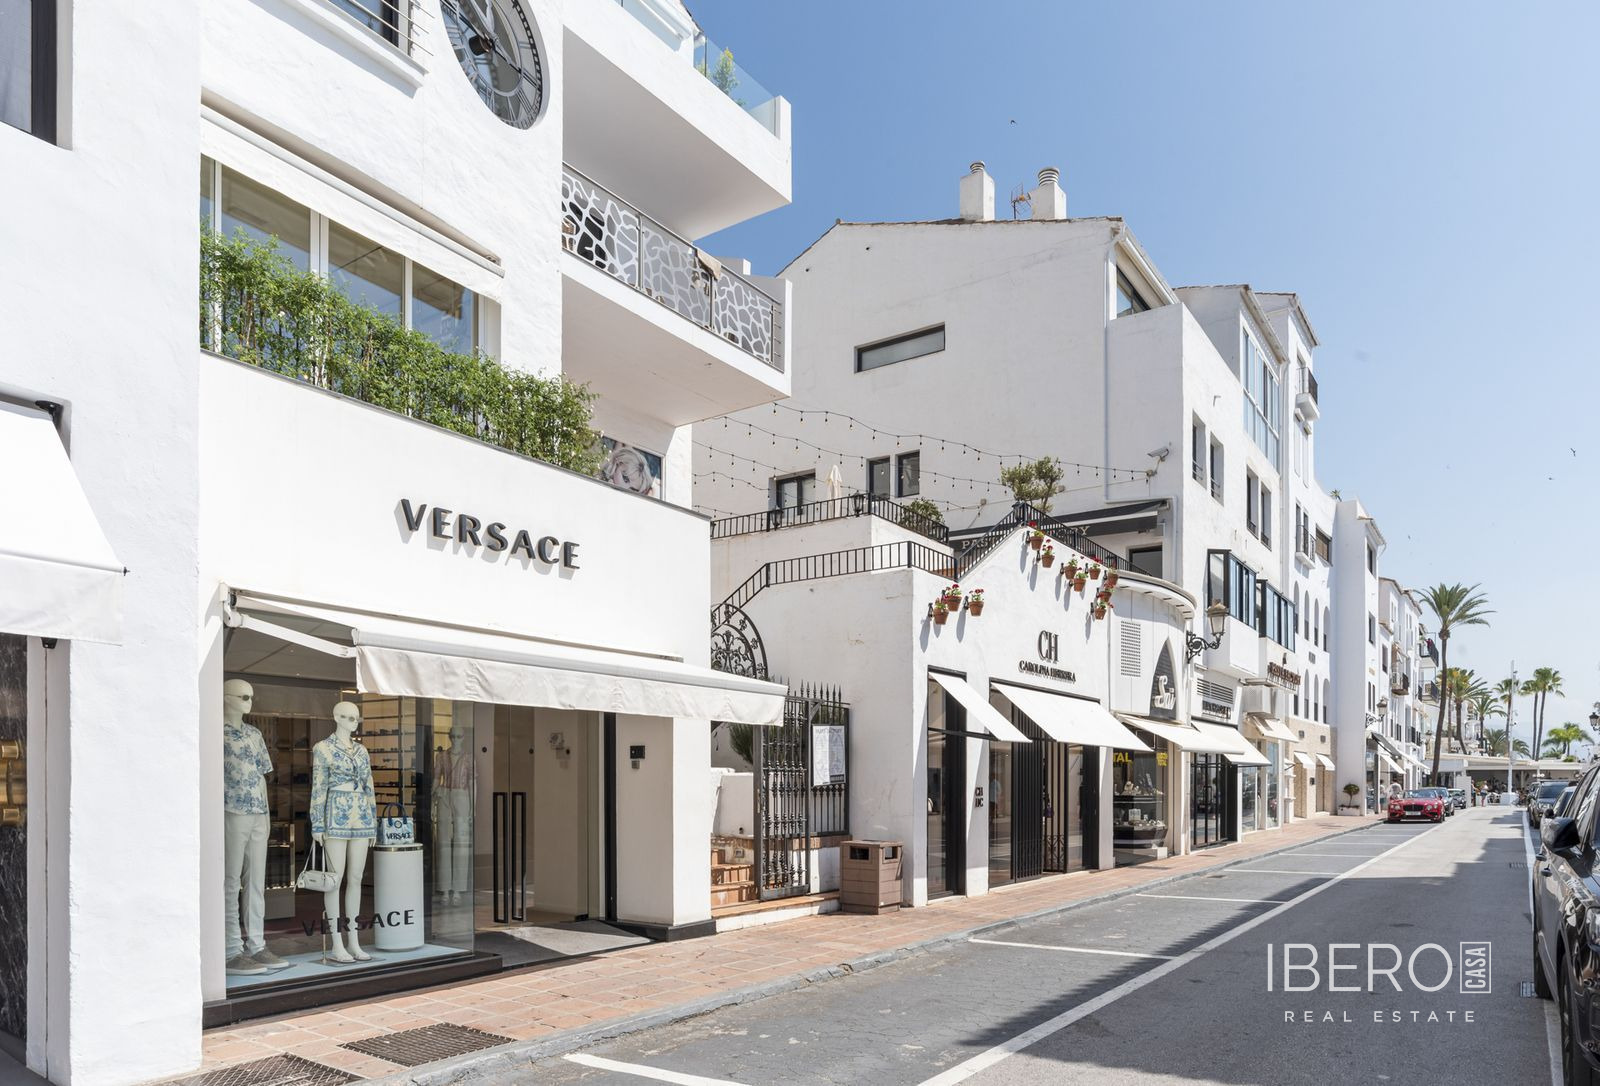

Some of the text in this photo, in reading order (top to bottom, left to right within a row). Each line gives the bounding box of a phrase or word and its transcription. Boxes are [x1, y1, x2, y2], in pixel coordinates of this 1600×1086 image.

[400, 498, 580, 569] VERSACE
[1038, 630, 1059, 662] CH
[386, 832, 411, 840] VERSACE
[302, 909, 415, 937] VERSACE
